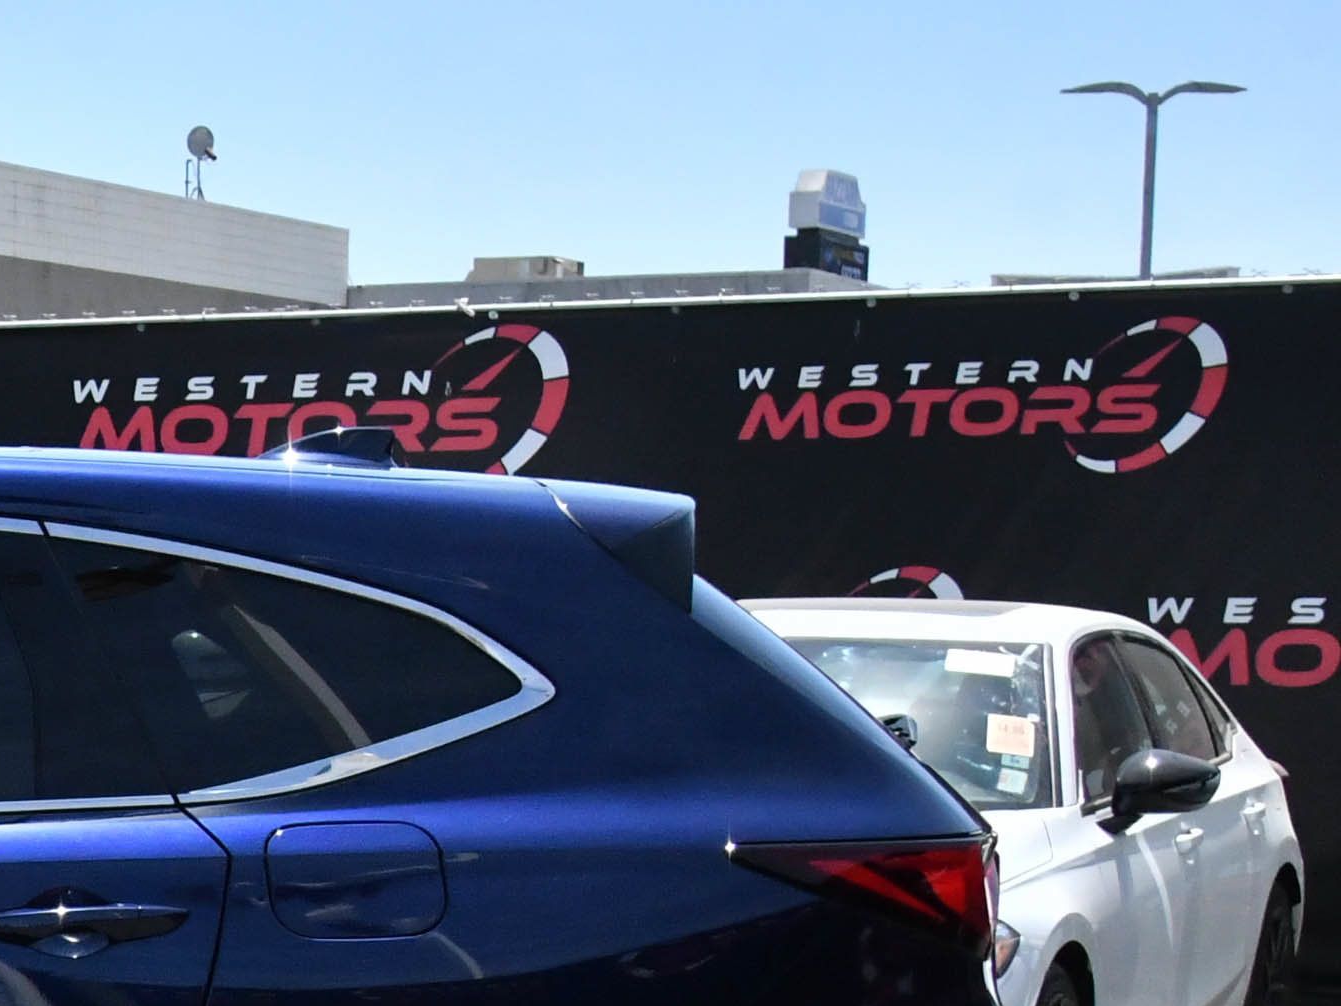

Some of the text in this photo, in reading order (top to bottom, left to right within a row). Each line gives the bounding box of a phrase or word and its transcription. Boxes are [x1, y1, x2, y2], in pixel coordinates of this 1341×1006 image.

[73, 370, 432, 403] WESTERN
[738, 358, 1094, 390] WESTERN
[80, 397, 501, 458] MOTORS
[738, 383, 1162, 441] MOTORS
[1147, 597, 1327, 624] WES
[1168, 627, 1341, 688] MO
